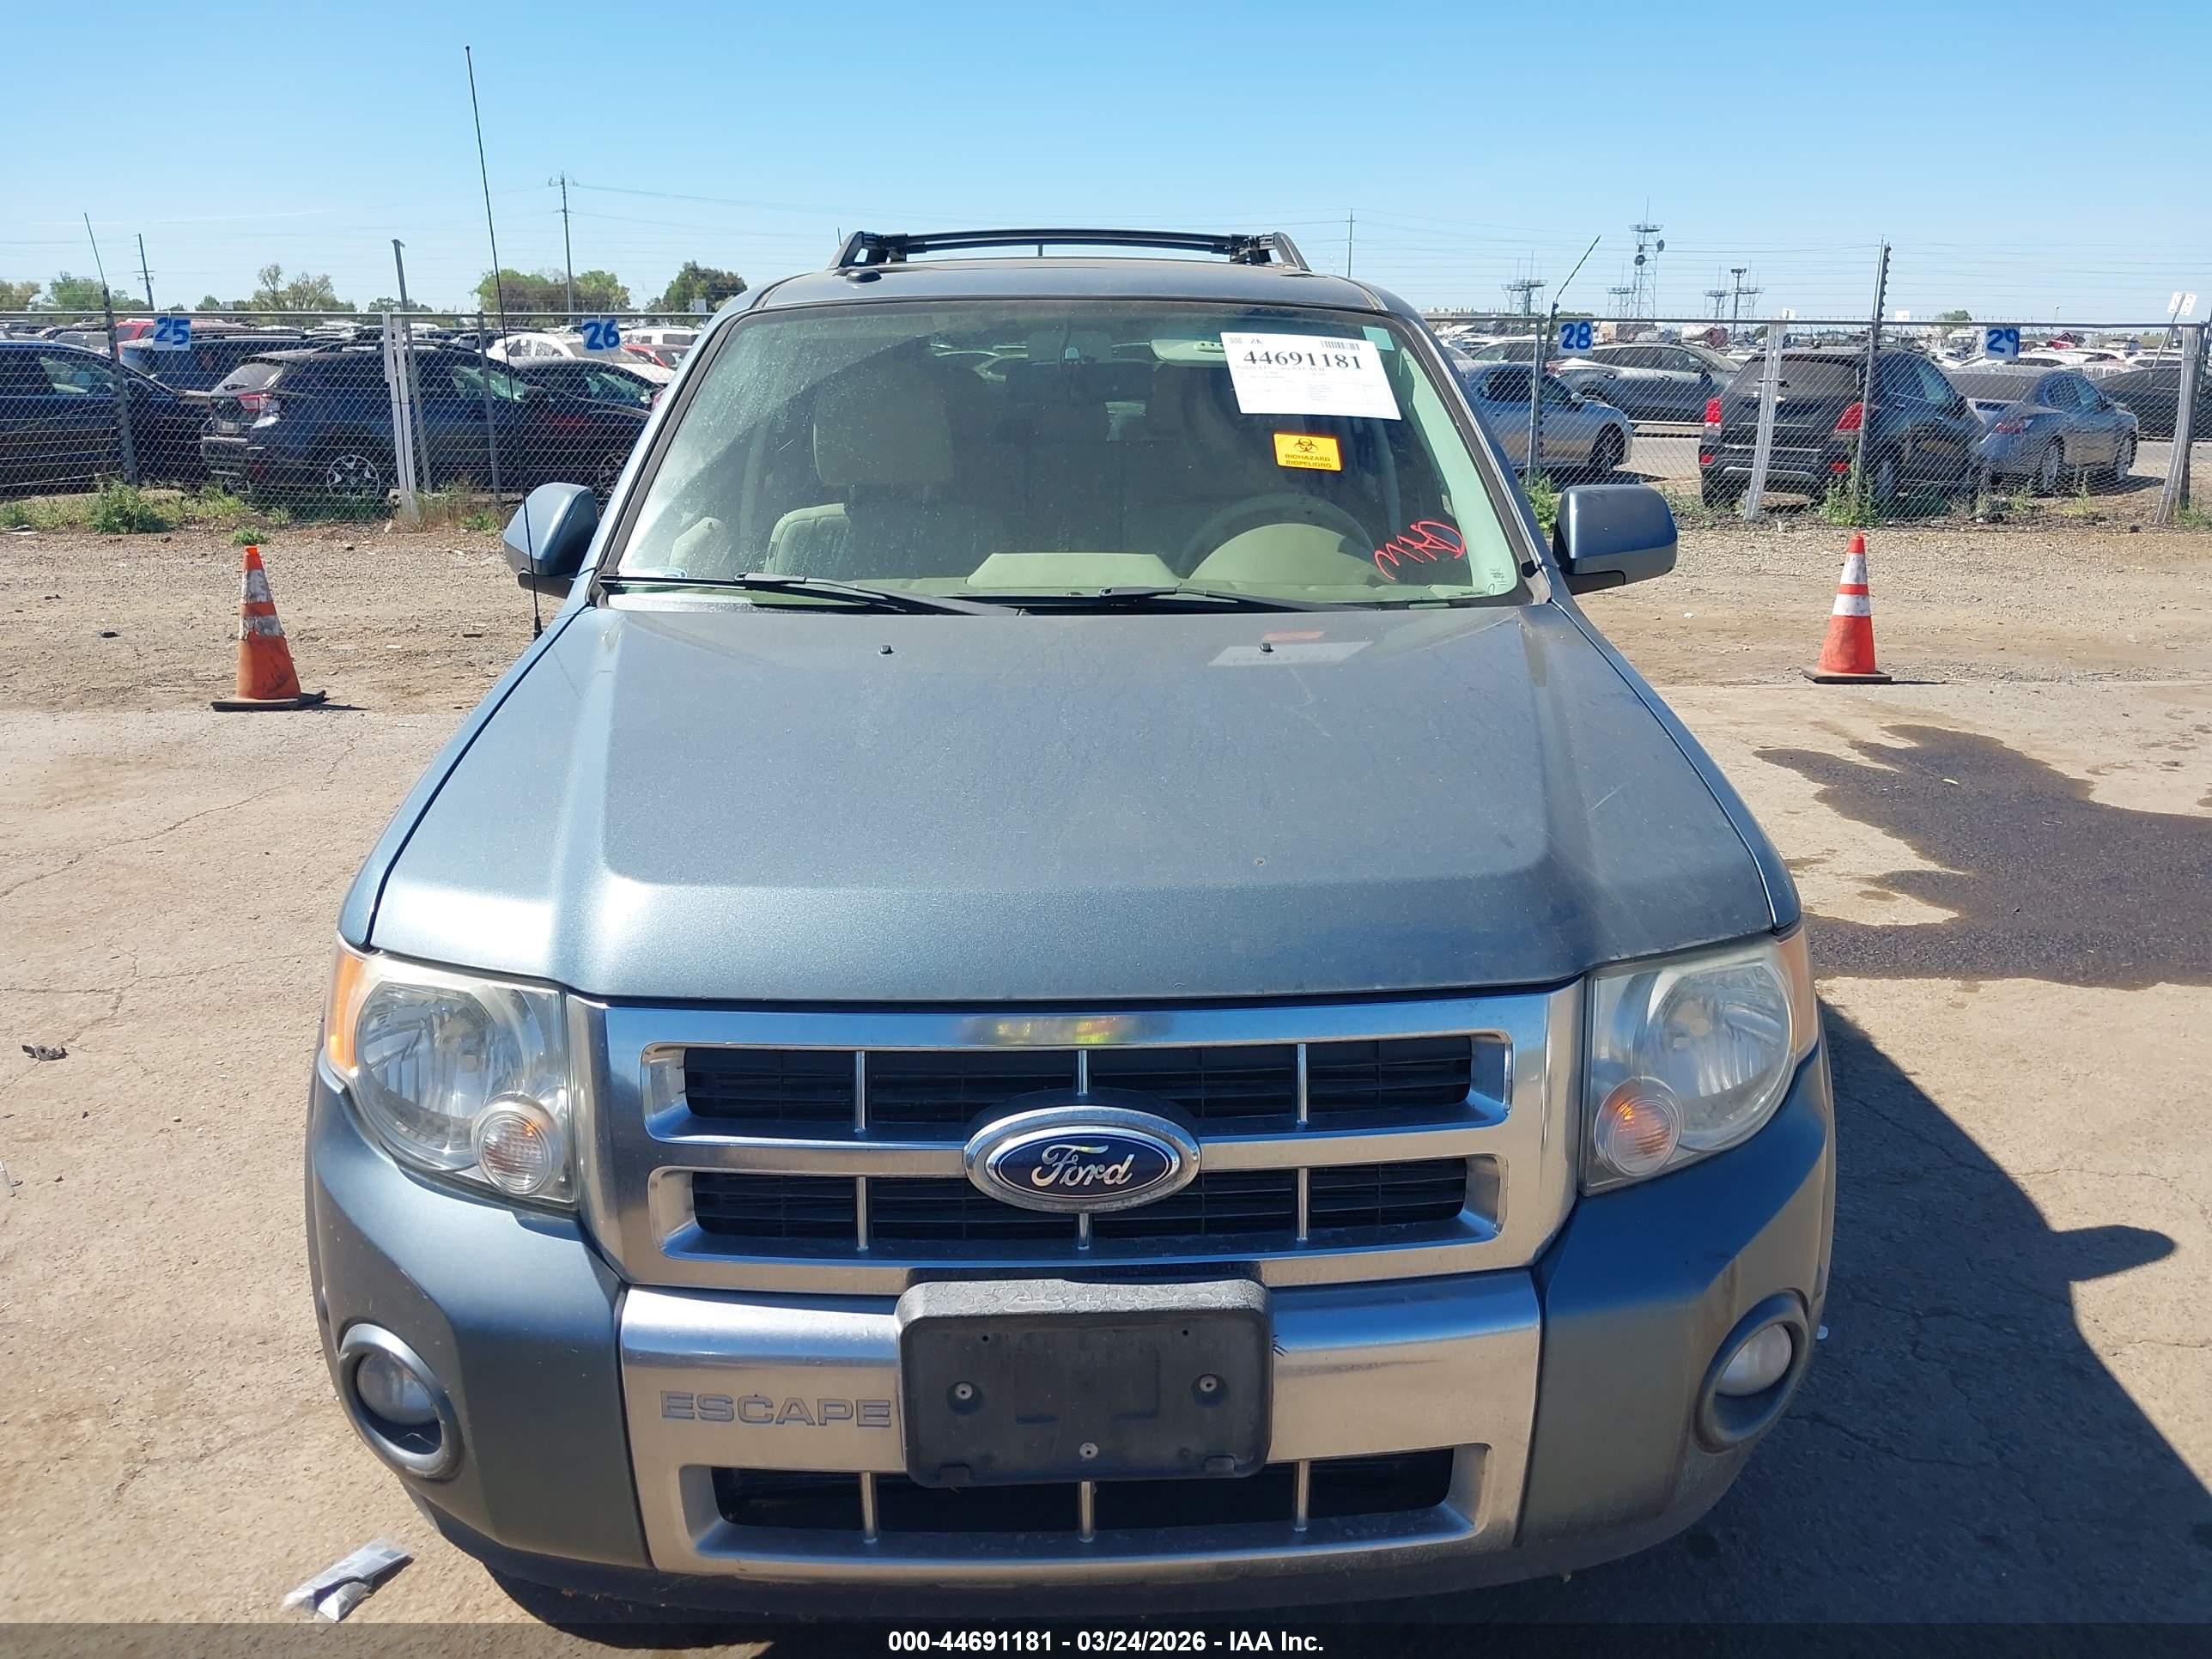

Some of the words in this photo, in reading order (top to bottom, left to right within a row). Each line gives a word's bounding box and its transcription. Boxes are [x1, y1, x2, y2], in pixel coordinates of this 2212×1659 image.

[155, 317, 191, 345] 25
[583, 319, 620, 349] 26
[1560, 321, 1591, 349] 28
[1987, 328, 2020, 356] 29
[1243, 350, 1363, 370] 44691181
[1285, 453, 1331, 462] BIOHAZARD
[1030, 1143, 1135, 1187] Ford
[659, 1390, 891, 1427] ESCAPE
